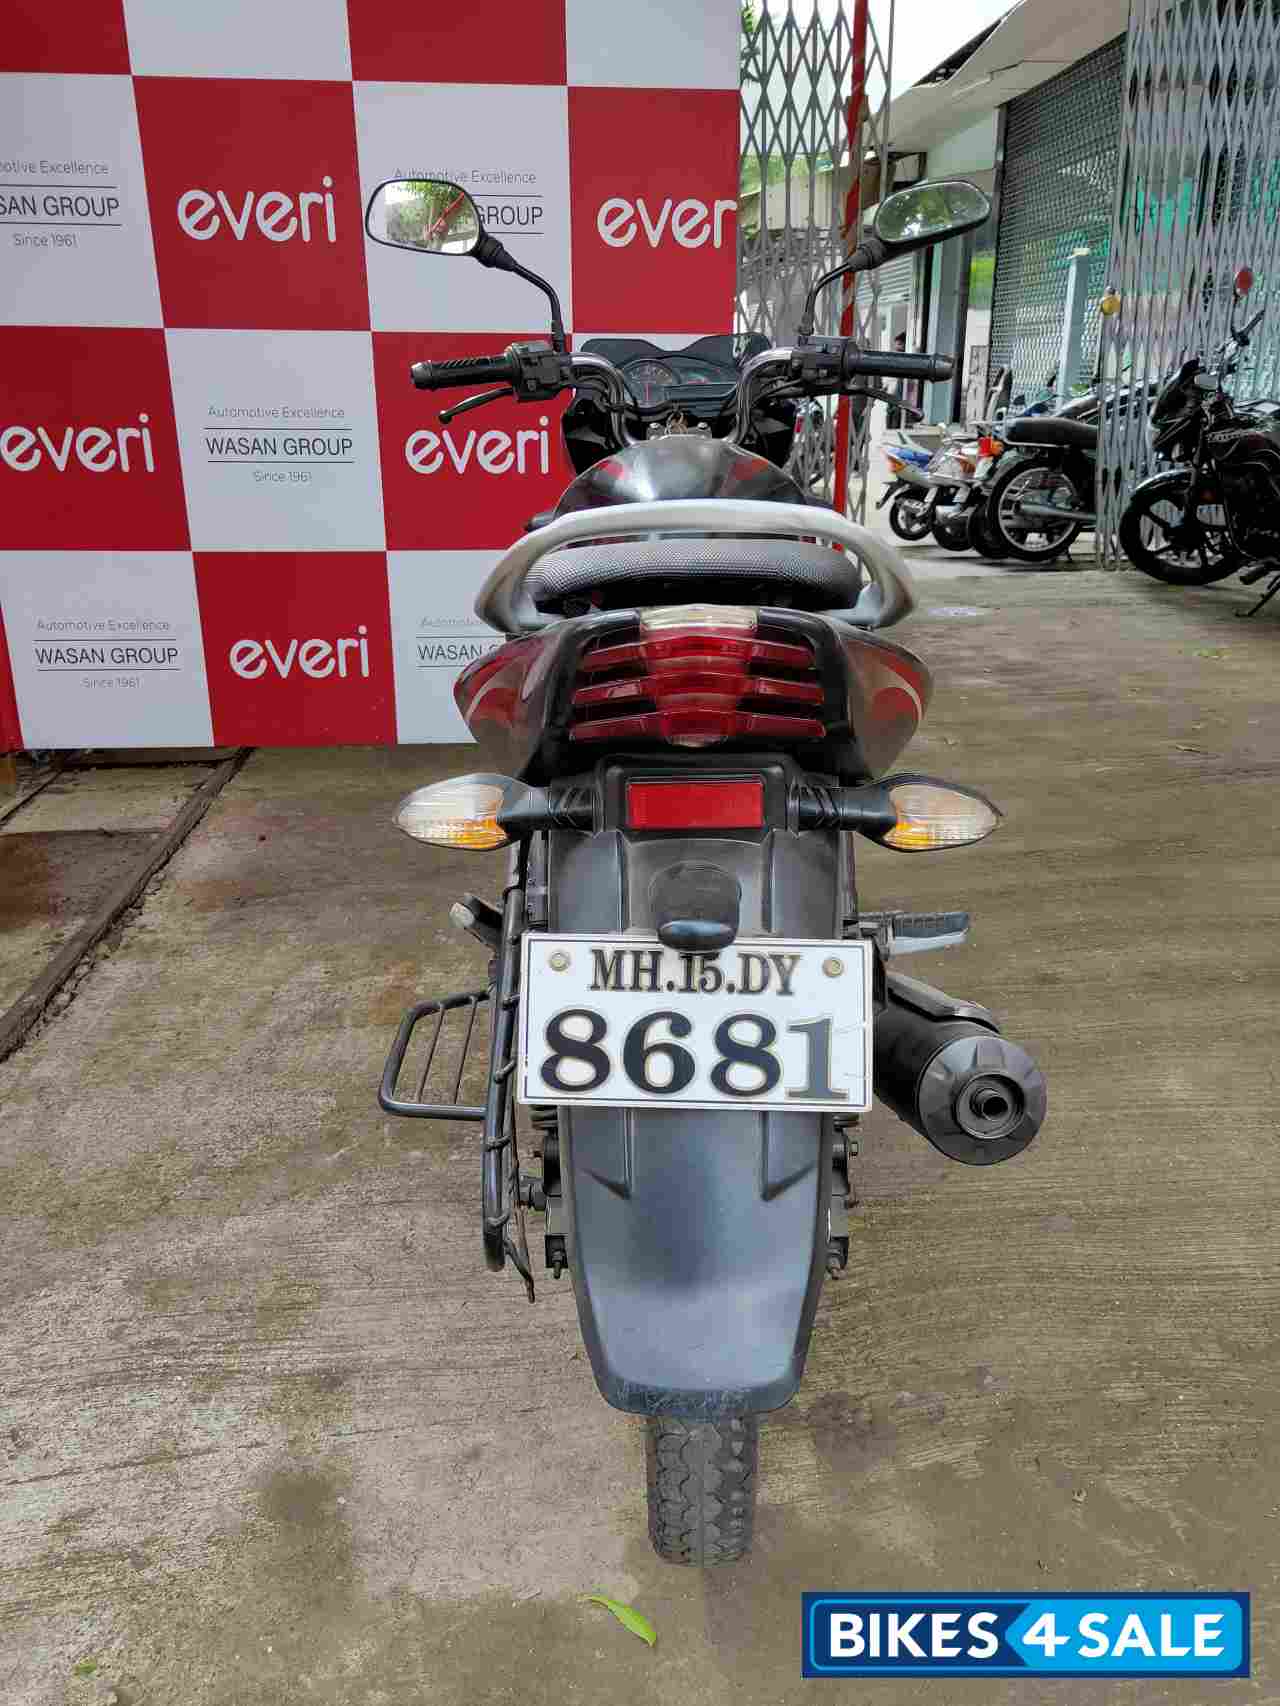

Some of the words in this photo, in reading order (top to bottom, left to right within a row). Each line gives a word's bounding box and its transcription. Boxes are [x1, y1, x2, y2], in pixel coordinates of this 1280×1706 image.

[0, 160, 37, 175] otive
[40, 160, 110, 175] Excellence
[471, 170, 537, 184] Excellence
[43, 195, 120, 217] GROUP
[177, 175, 337, 242] everi
[597, 198, 737, 248] ever
[14, 232, 48, 247] Since
[51, 232, 77, 248] 1961
[208, 406, 279, 418] Automotive
[282, 406, 345, 419] Excellence
[0, 413, 155, 472] everi
[206, 437, 277, 456] WASAN
[283, 437, 353, 457] GROUP
[405, 415, 549, 474] everi
[253, 471, 286, 482] Since
[289, 471, 312, 482] 1961
[37, 619, 105, 632] Automotive
[107, 618, 170, 632] Excellence
[35, 647, 105, 664] WASAN
[110, 647, 178, 664] GROUP
[229, 625, 369, 679] everi
[418, 644, 482, 660] WASAN
[81, 678, 113, 689] Since
[116, 677, 141, 689] 1961
[541, 1008, 849, 1100] 8681
